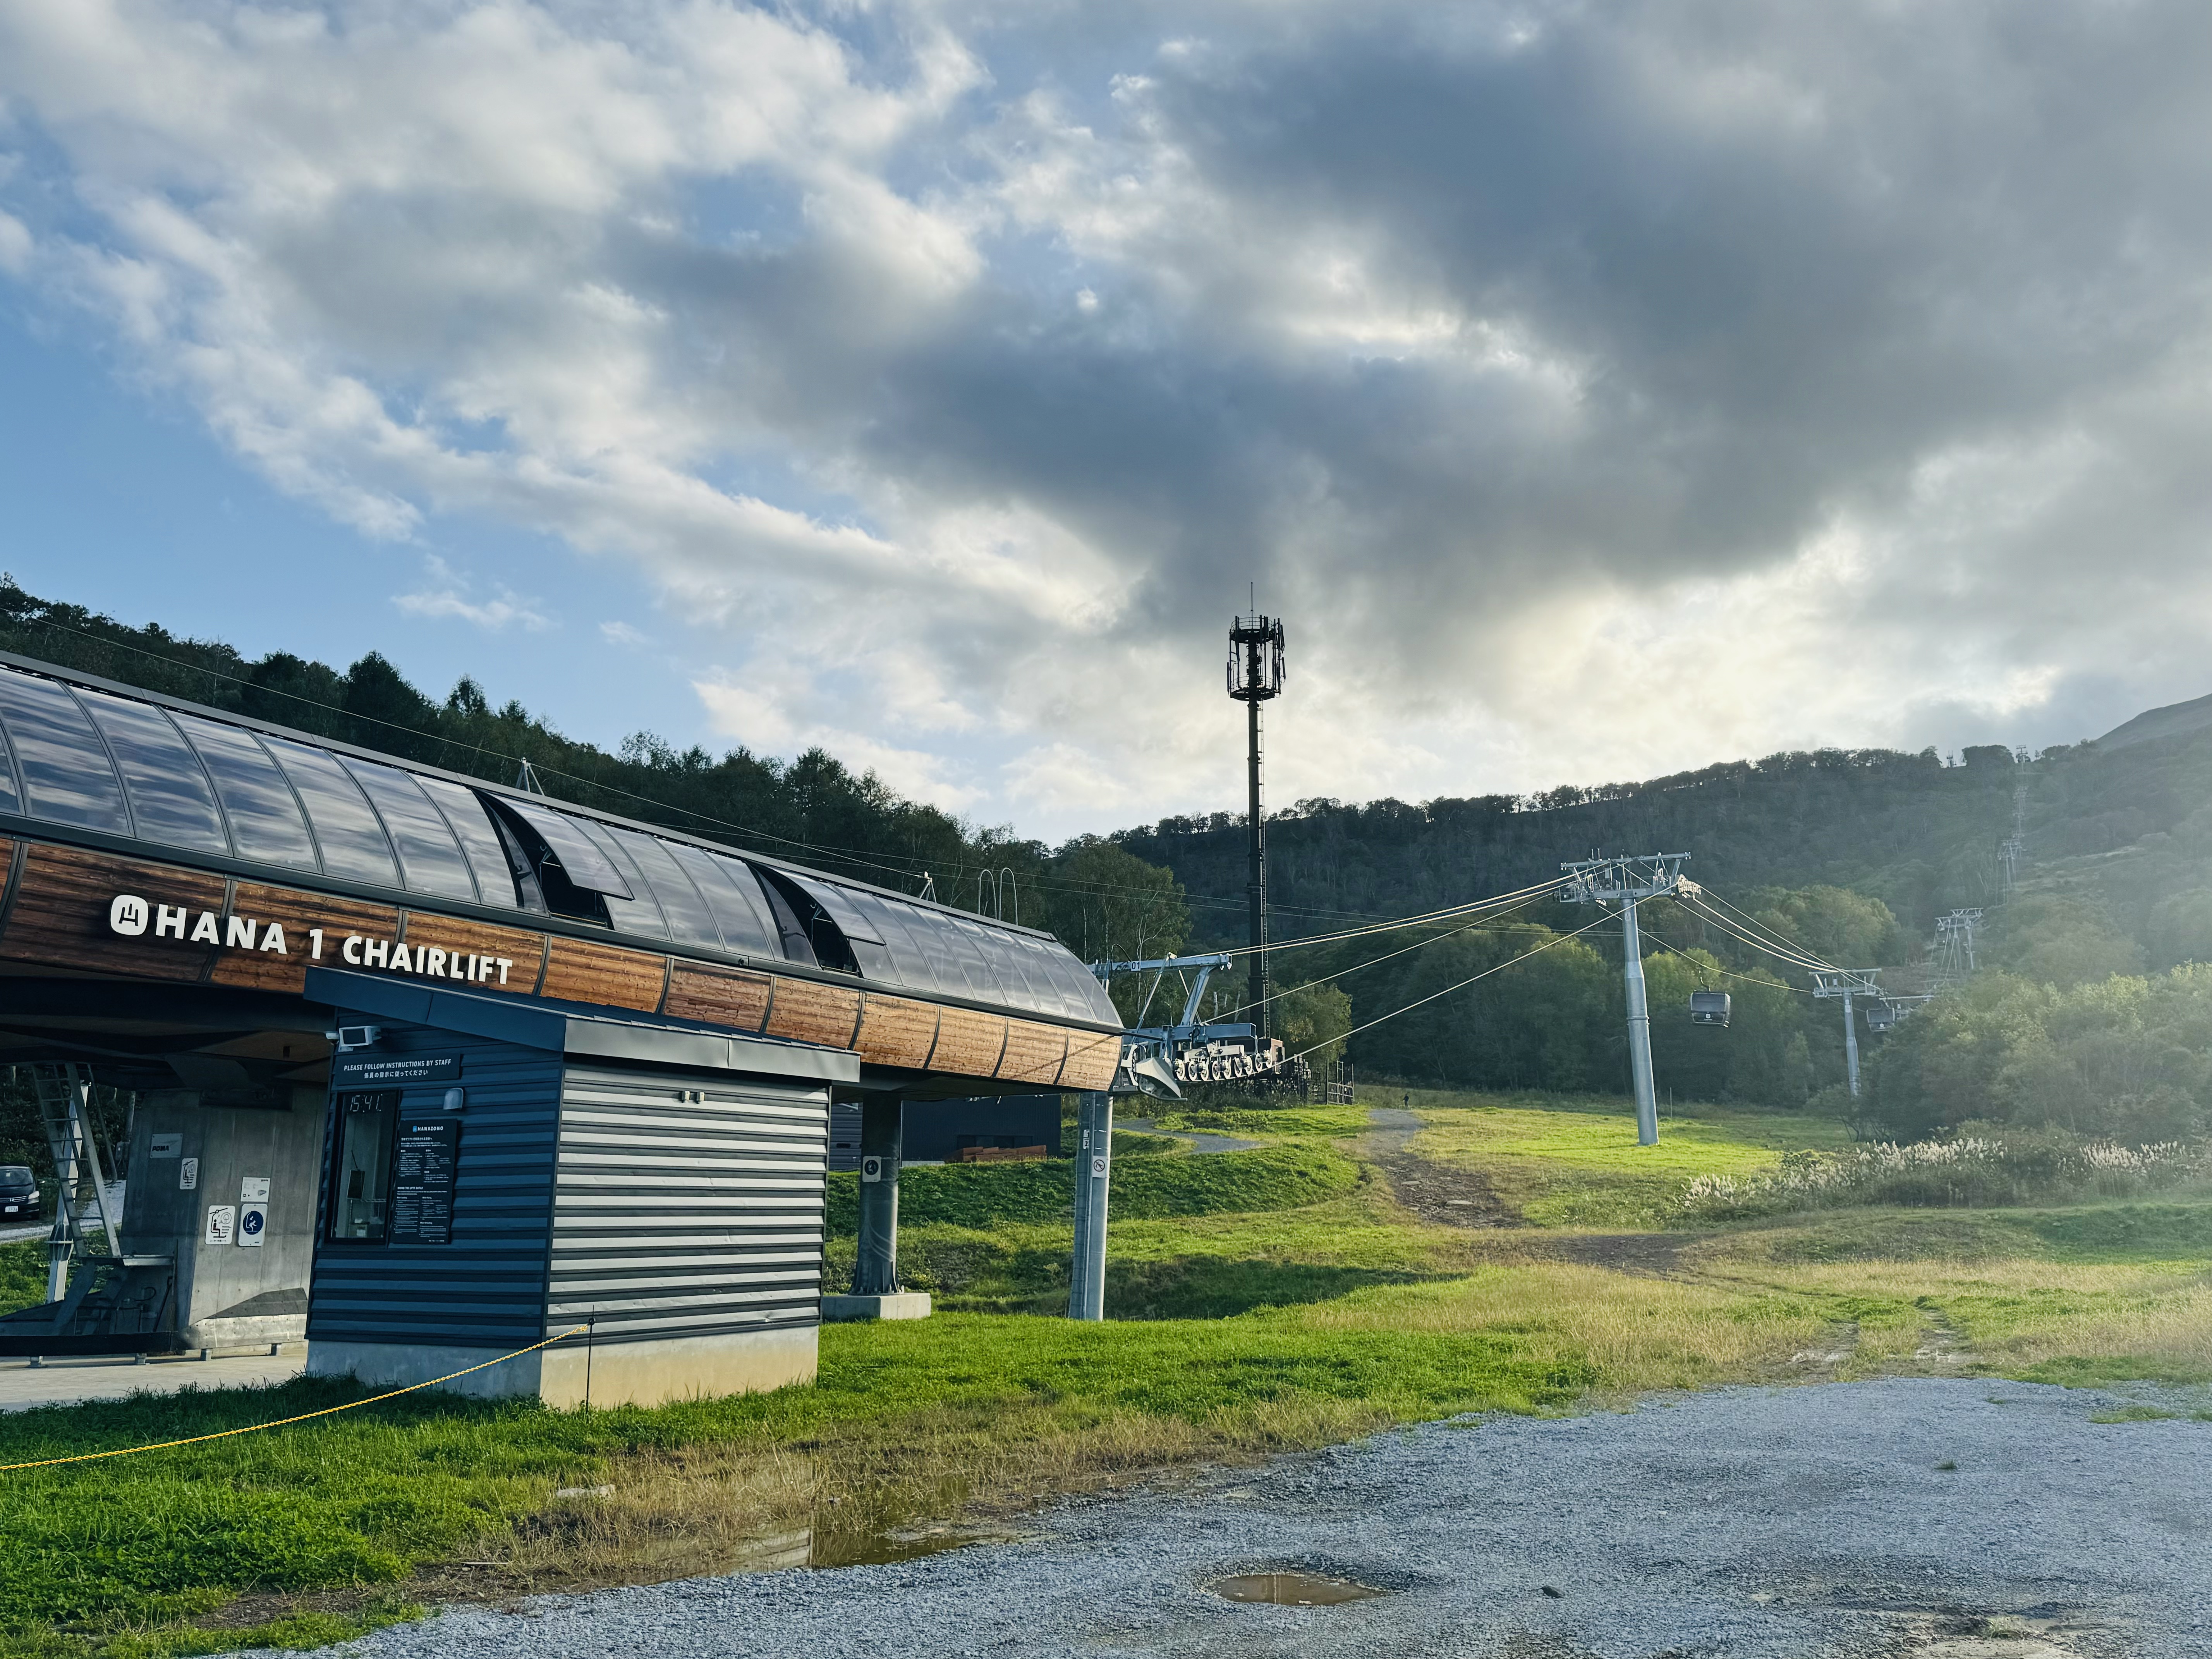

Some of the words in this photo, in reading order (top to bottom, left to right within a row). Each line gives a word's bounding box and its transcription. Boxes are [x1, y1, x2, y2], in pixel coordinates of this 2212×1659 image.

[156, 904, 287, 954] HANA
[310, 929, 323, 959] 1
[343, 936, 513, 984] CHAIRLIFT
[386, 1061, 425, 1069] INSTRUCTIONS
[364, 1070, 428, 1079] 係員の指示に従ってください
[350, 1095, 380, 1113] 15:41
